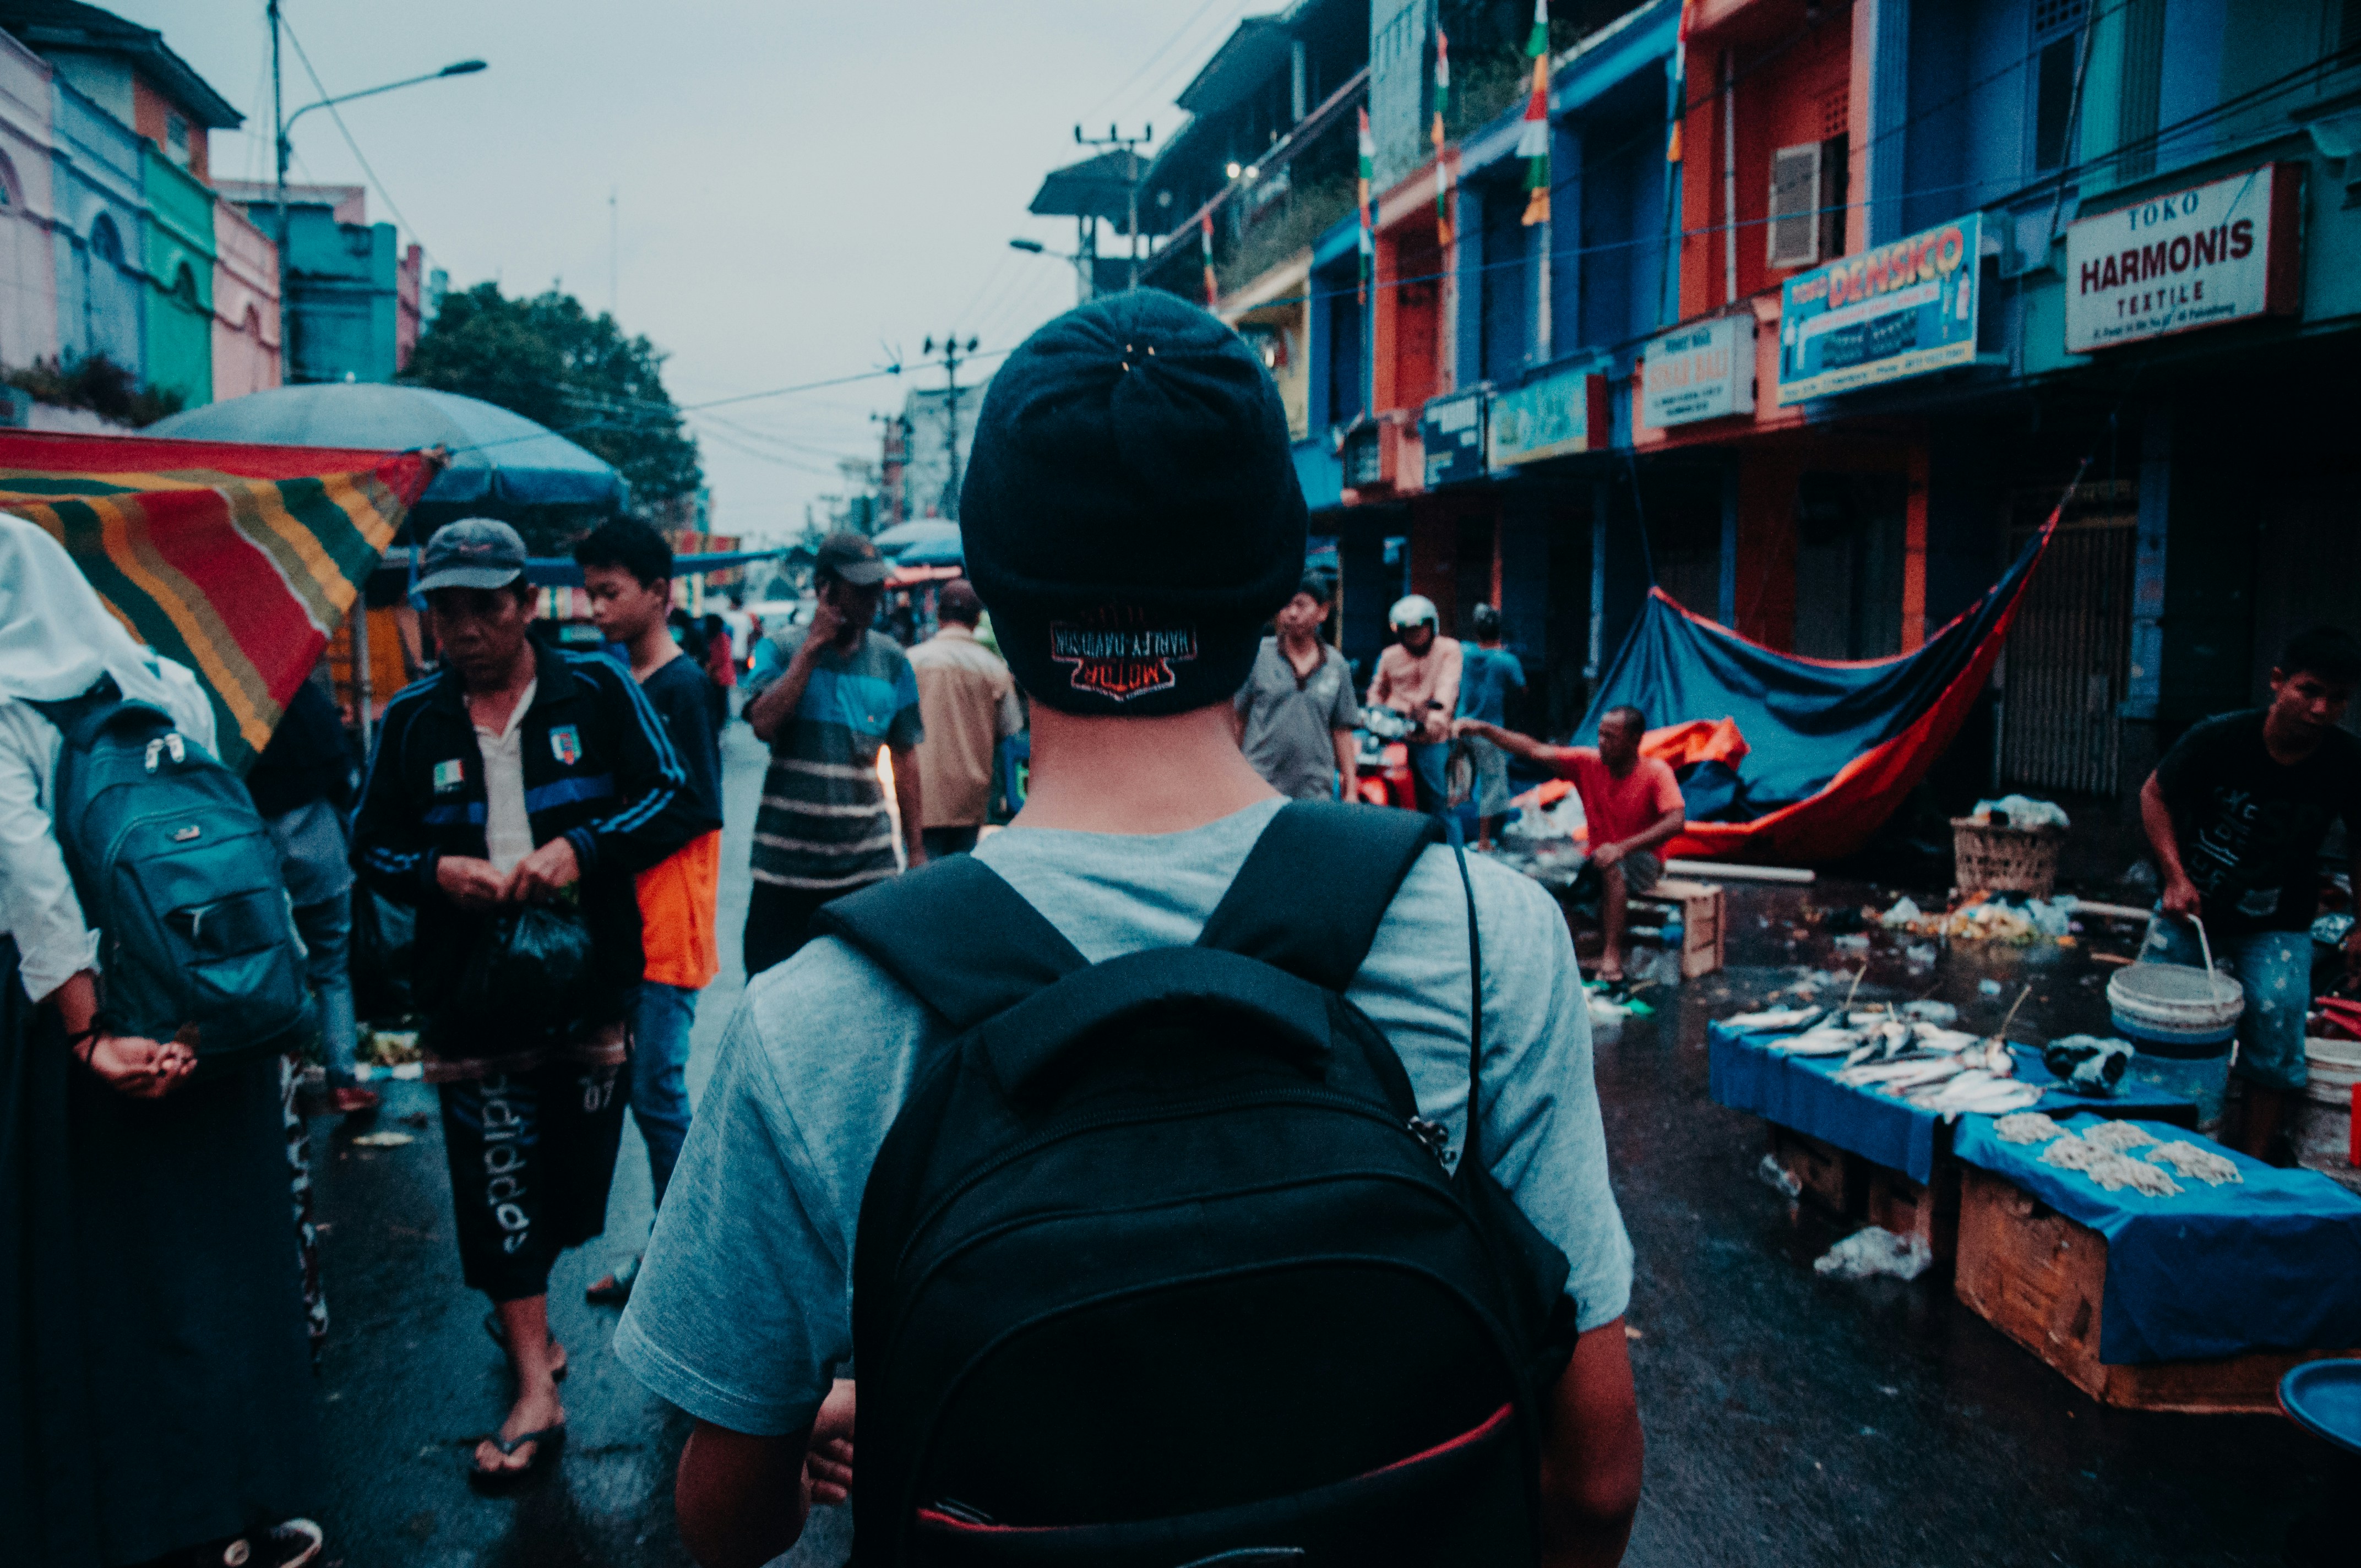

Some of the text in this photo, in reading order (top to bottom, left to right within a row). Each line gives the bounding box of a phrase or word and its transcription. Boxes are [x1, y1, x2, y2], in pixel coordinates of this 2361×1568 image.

[2127, 190, 2199, 231] TOKO
[1828, 226, 1963, 309] DENSICO
[2080, 219, 2254, 296] HARMONIS
[2117, 280, 2203, 318] TEXTILE
[1083, 662, 1160, 692] MOTOR
